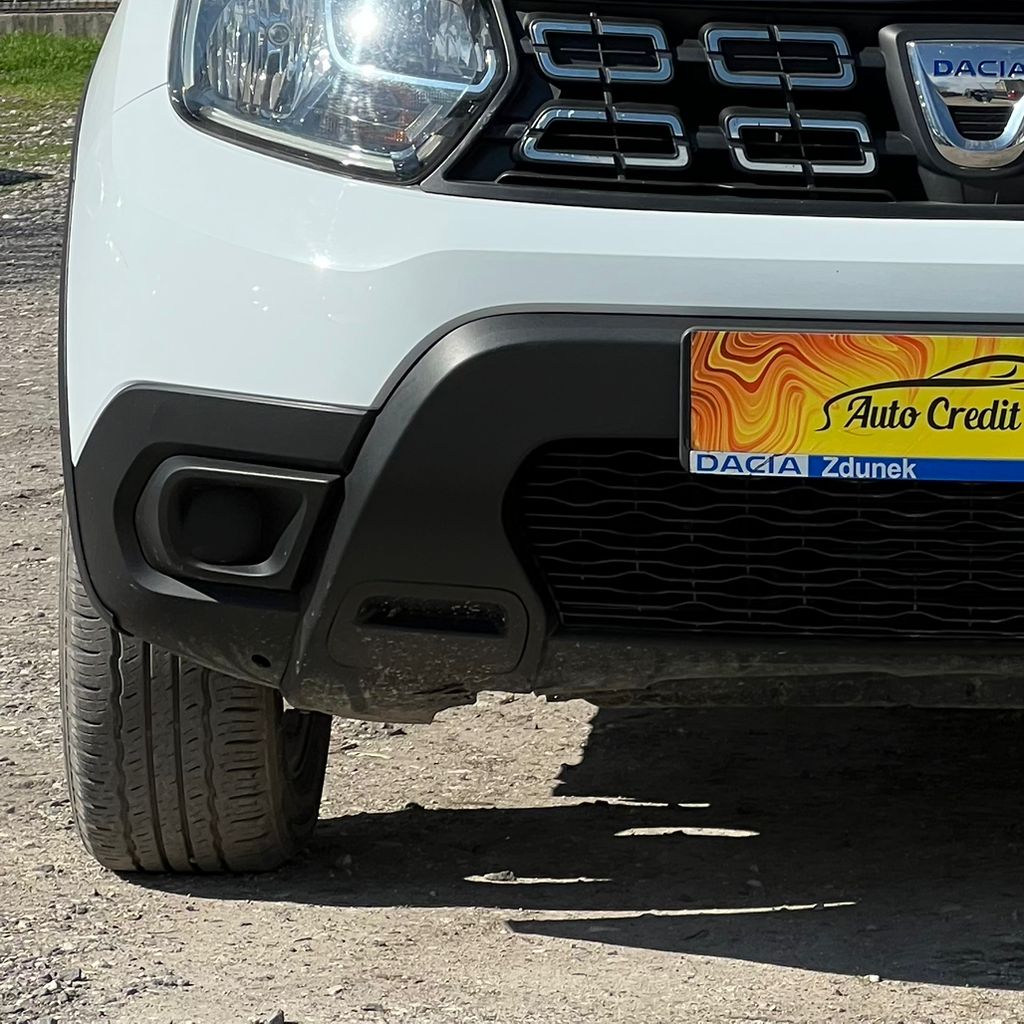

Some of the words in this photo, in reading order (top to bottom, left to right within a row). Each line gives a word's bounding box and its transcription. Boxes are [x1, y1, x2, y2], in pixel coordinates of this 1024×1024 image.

[844, 395, 920, 429] Auto
[927, 396, 1022, 431] Credit
[696, 453, 801, 474] DACIA
[821, 456, 917, 479] Zdunek
